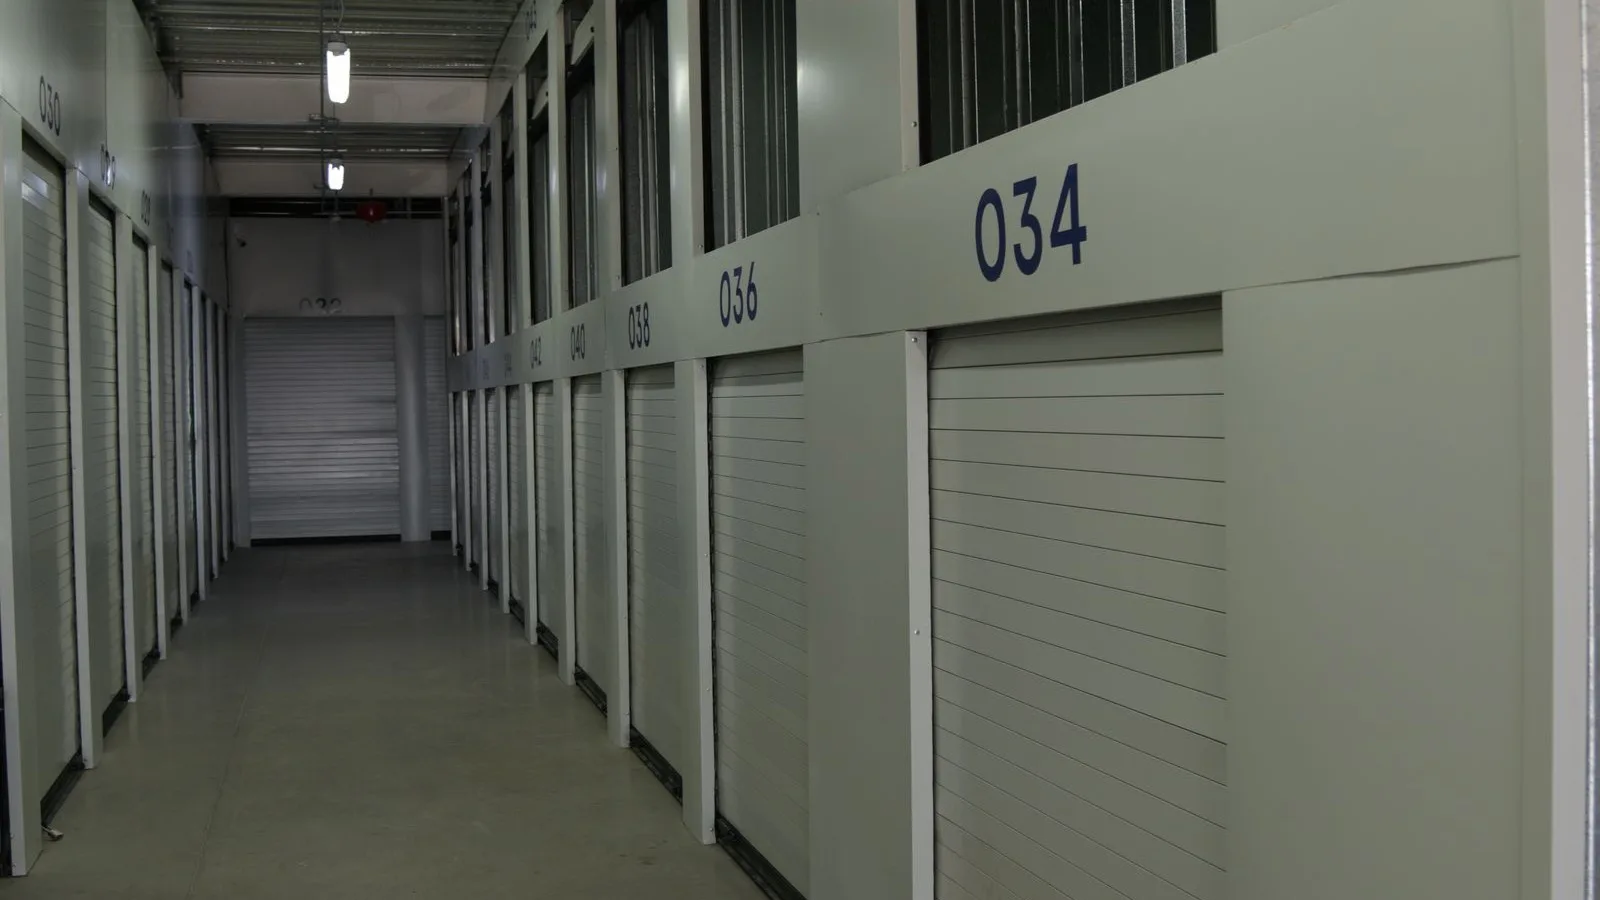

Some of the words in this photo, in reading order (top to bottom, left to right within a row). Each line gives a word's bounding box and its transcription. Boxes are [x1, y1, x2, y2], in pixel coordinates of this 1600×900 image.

[39, 75, 61, 136] 030
[975, 163, 1087, 283] 034
[719, 261, 758, 328] 036
[570, 323, 586, 361] 040
[628, 301, 651, 350] 038
